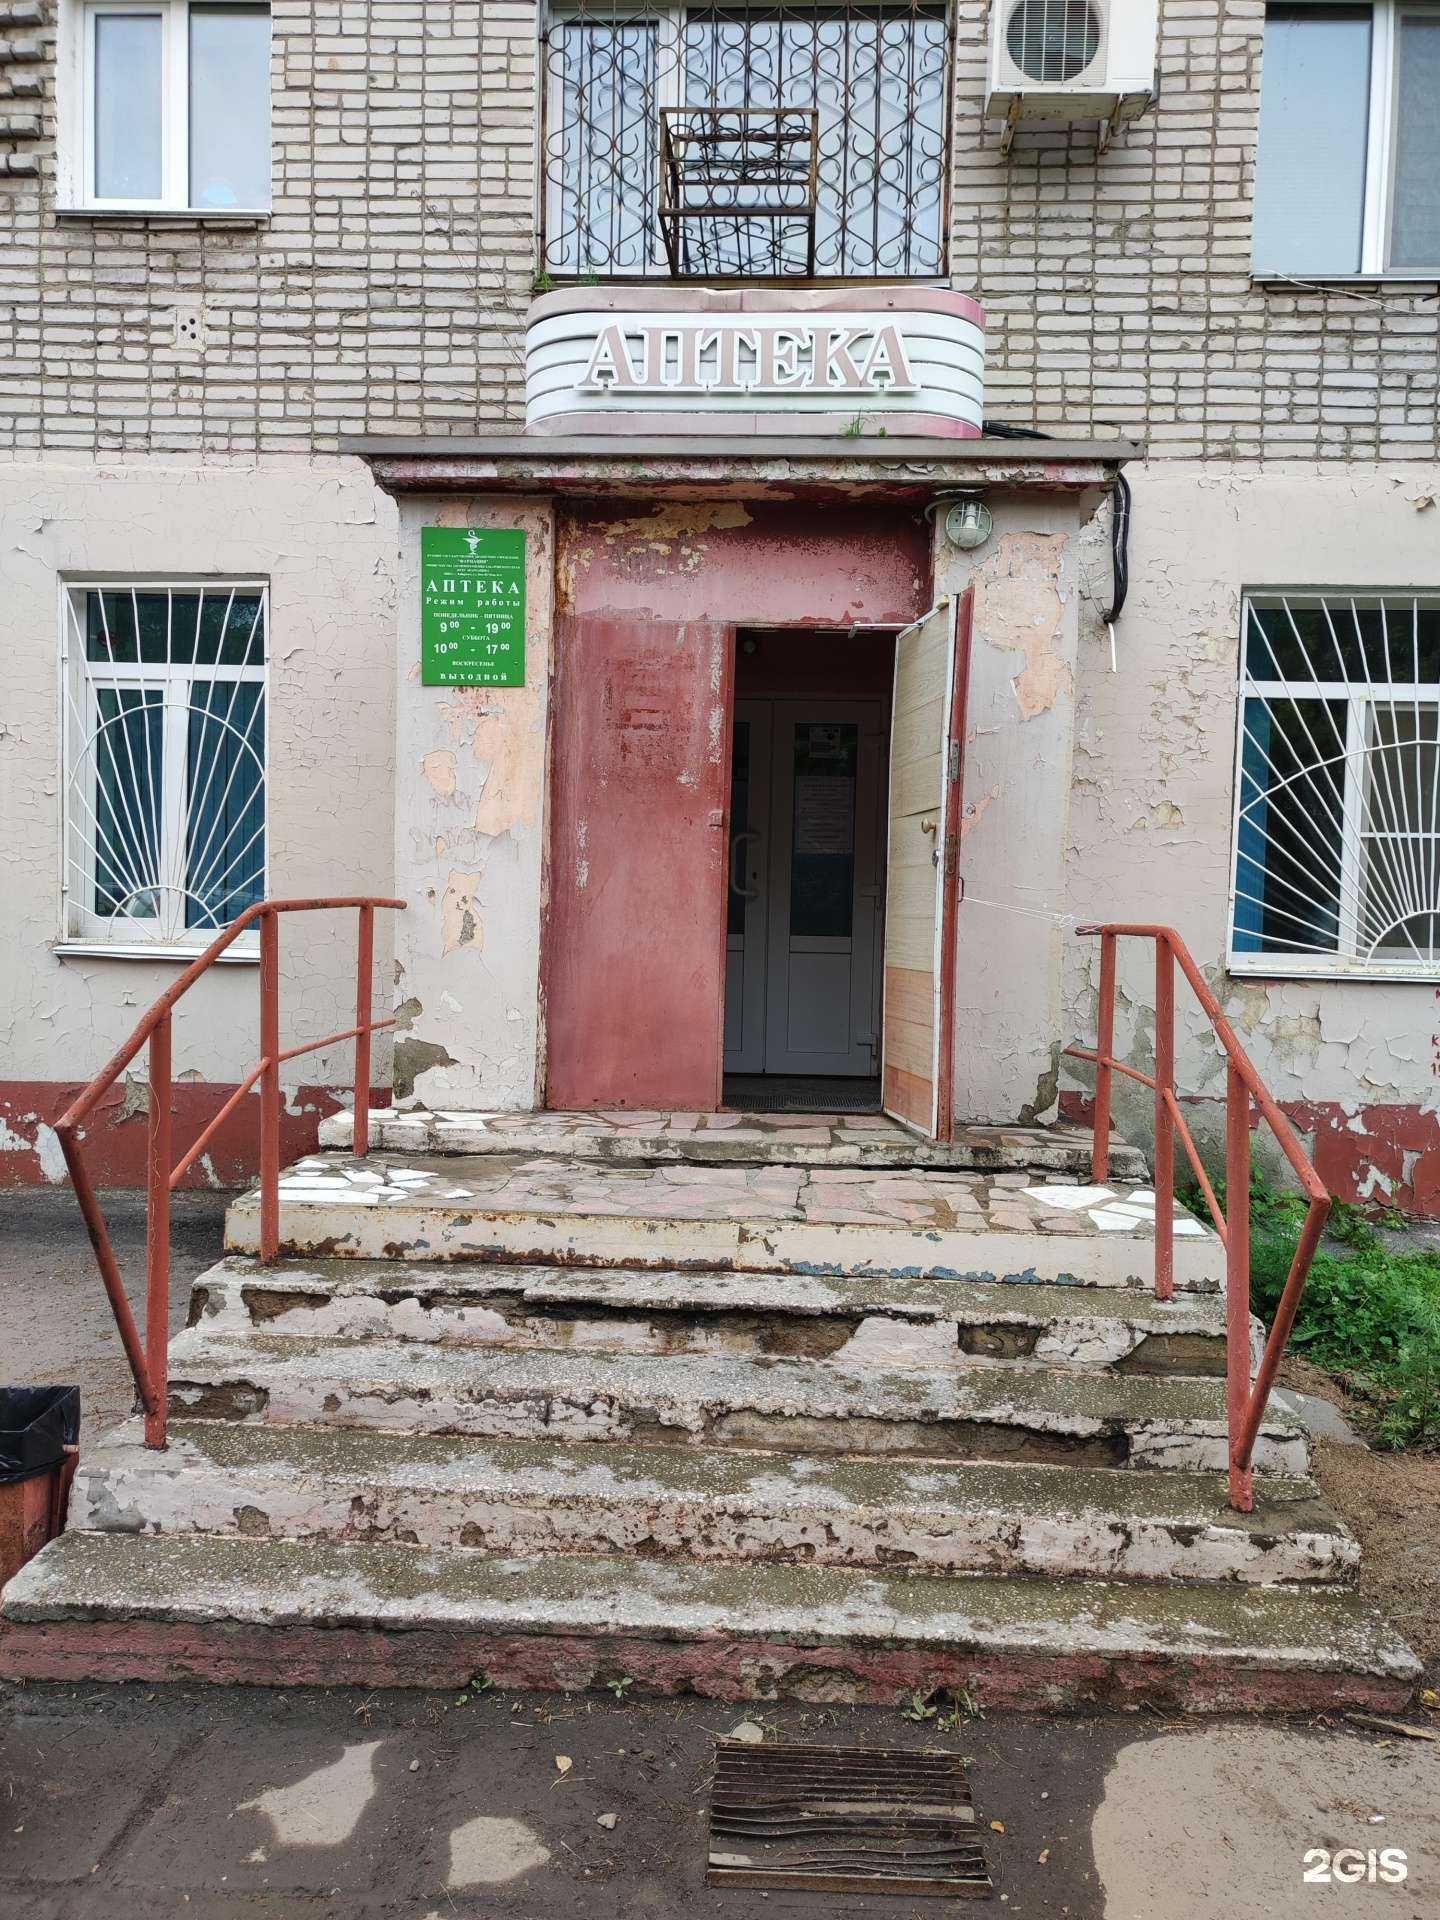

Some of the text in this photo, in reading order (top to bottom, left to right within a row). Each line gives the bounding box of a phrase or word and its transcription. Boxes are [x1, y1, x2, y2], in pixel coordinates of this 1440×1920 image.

[575, 323, 921, 392] АПТЕКА
[426, 579, 520, 594] АПТЕКА
[426, 597, 520, 608] Режим работы
